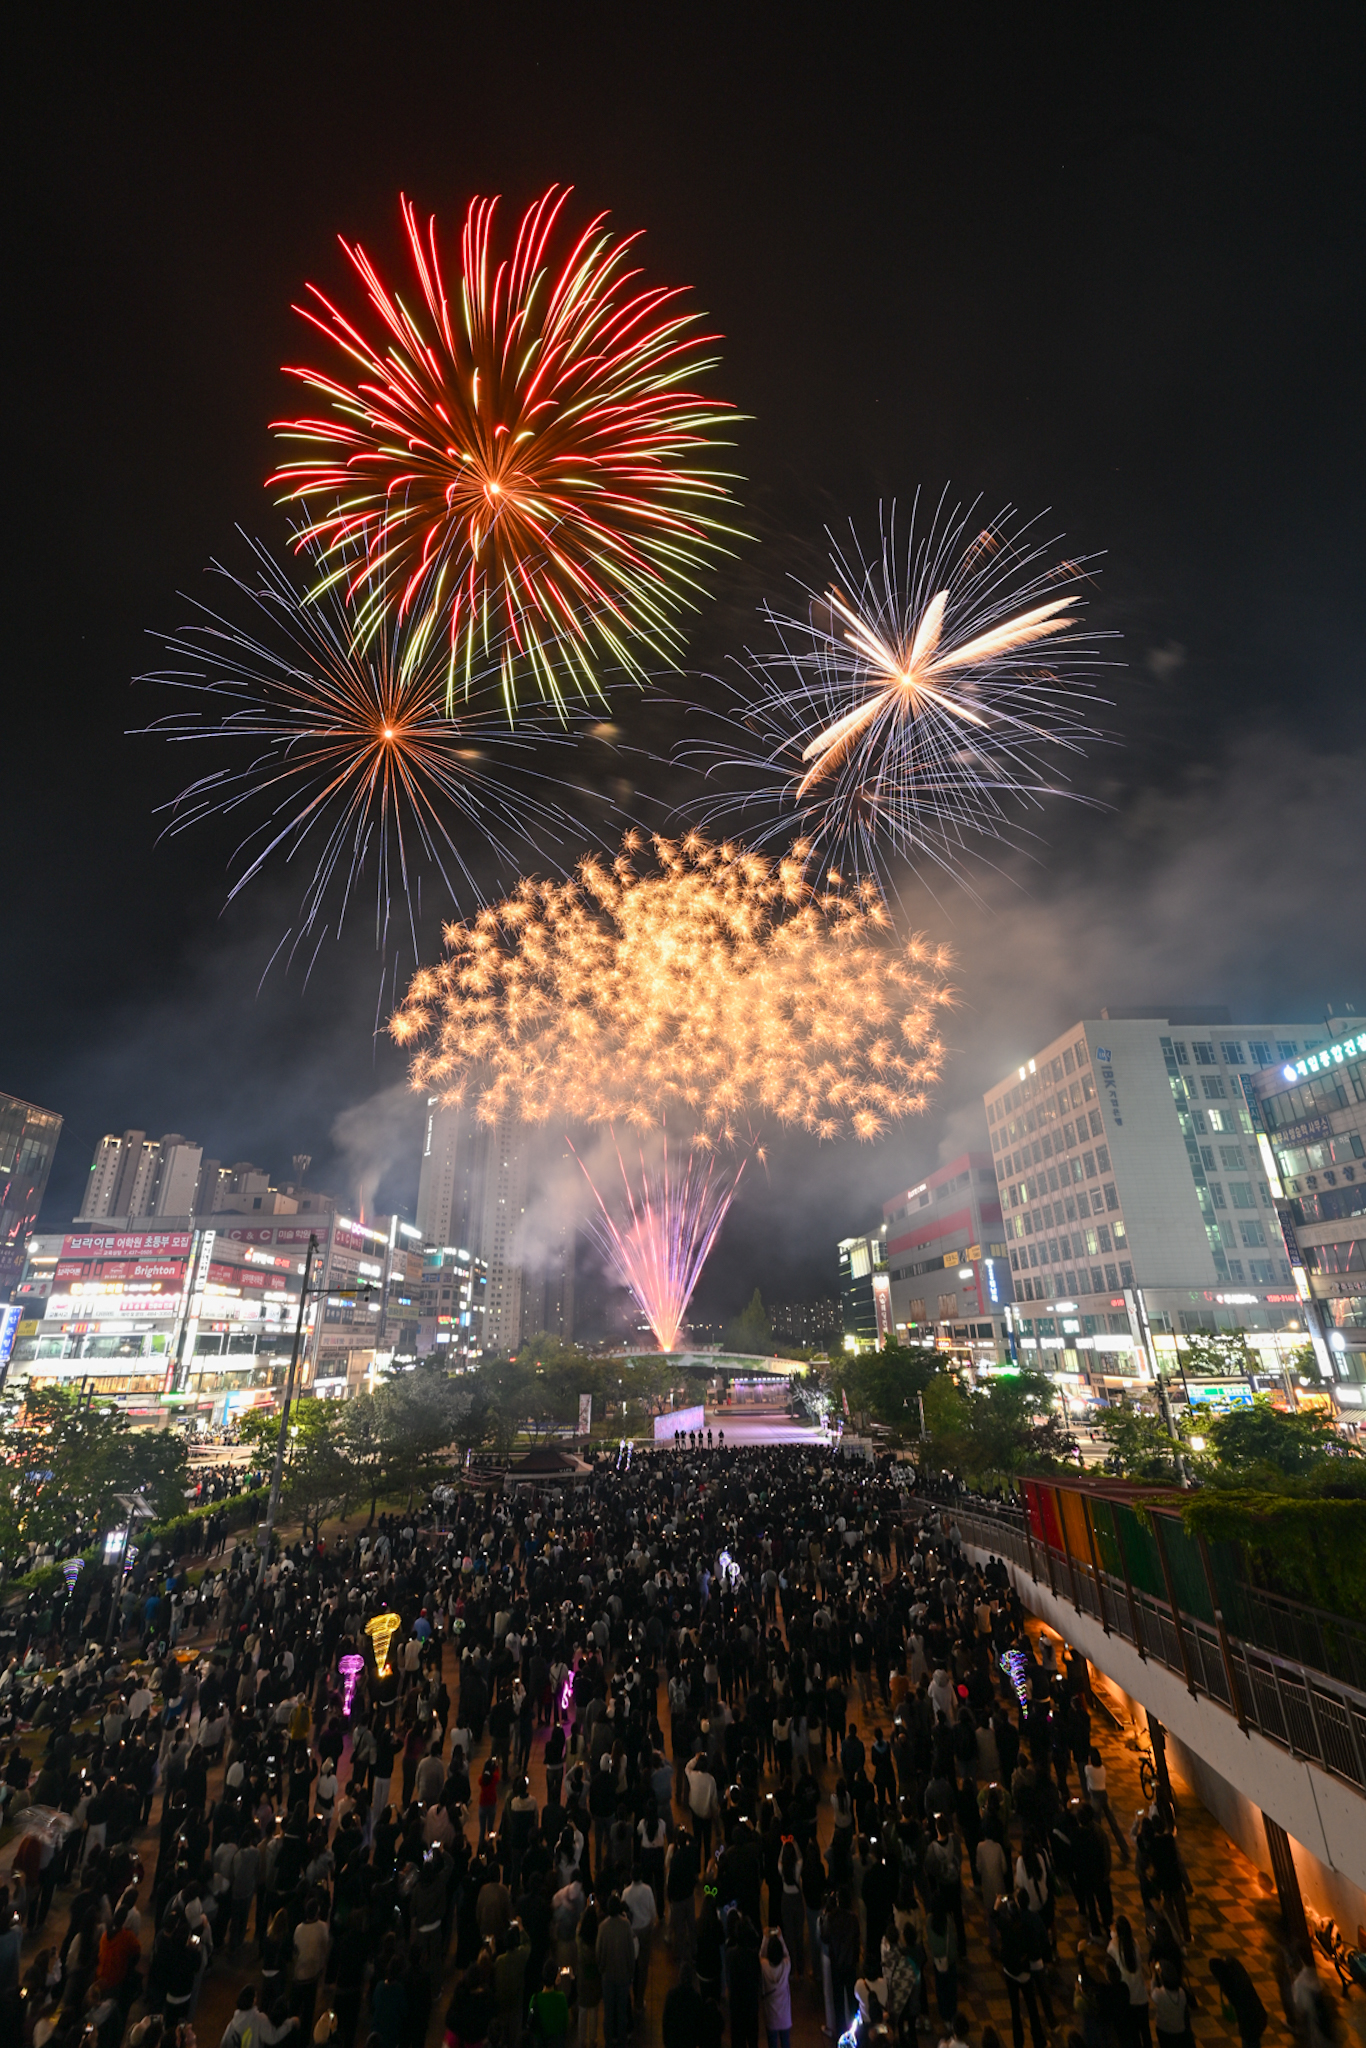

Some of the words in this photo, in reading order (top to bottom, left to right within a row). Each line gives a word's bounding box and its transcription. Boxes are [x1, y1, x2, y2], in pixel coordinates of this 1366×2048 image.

[1101, 1066, 1117, 1089] IBK
[70, 1237, 116, 1249] 브라이튼
[116, 1237, 143, 1248] 어학원
[143, 1235, 170, 1248] 초등부
[171, 1236, 190, 1248] 모집
[13, 1255, 24, 1267] 4F
[57, 1267, 82, 1277] 브라이튼
[134, 1265, 176, 1278] Brighton
